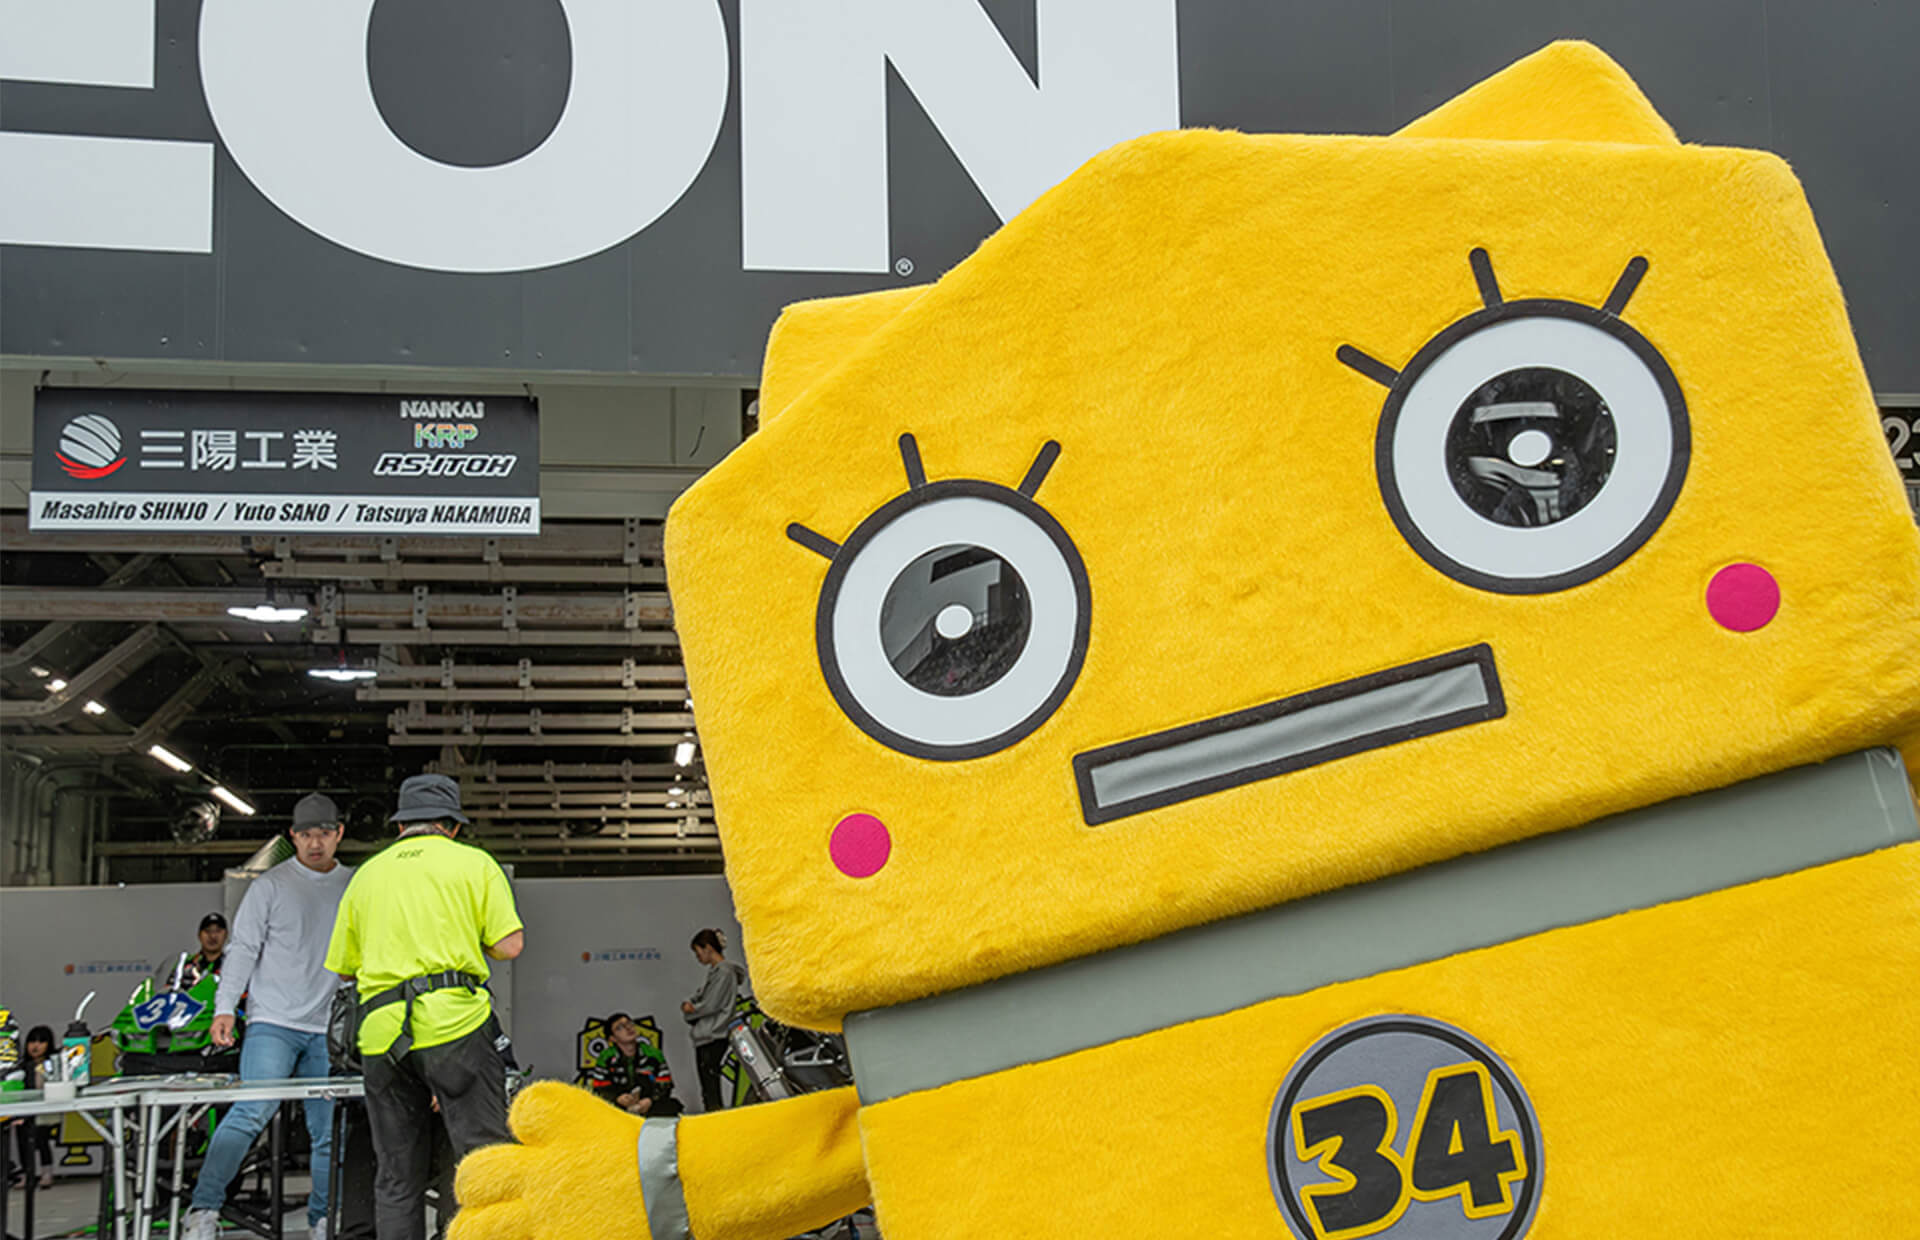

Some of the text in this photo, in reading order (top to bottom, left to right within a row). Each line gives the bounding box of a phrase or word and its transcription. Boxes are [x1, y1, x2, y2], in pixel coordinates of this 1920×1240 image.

[140, 430, 337, 471] 三陽工業
[414, 423, 479, 448] KRP
[1880, 416, 1920, 470] 2
[373, 453, 518, 477] RS-ITOH
[41, 501, 532, 525] Masahiro SHINJO / Yuto SANO / Tatsuya NAKAMURA
[1292, 1062, 1526, 1240] 34
